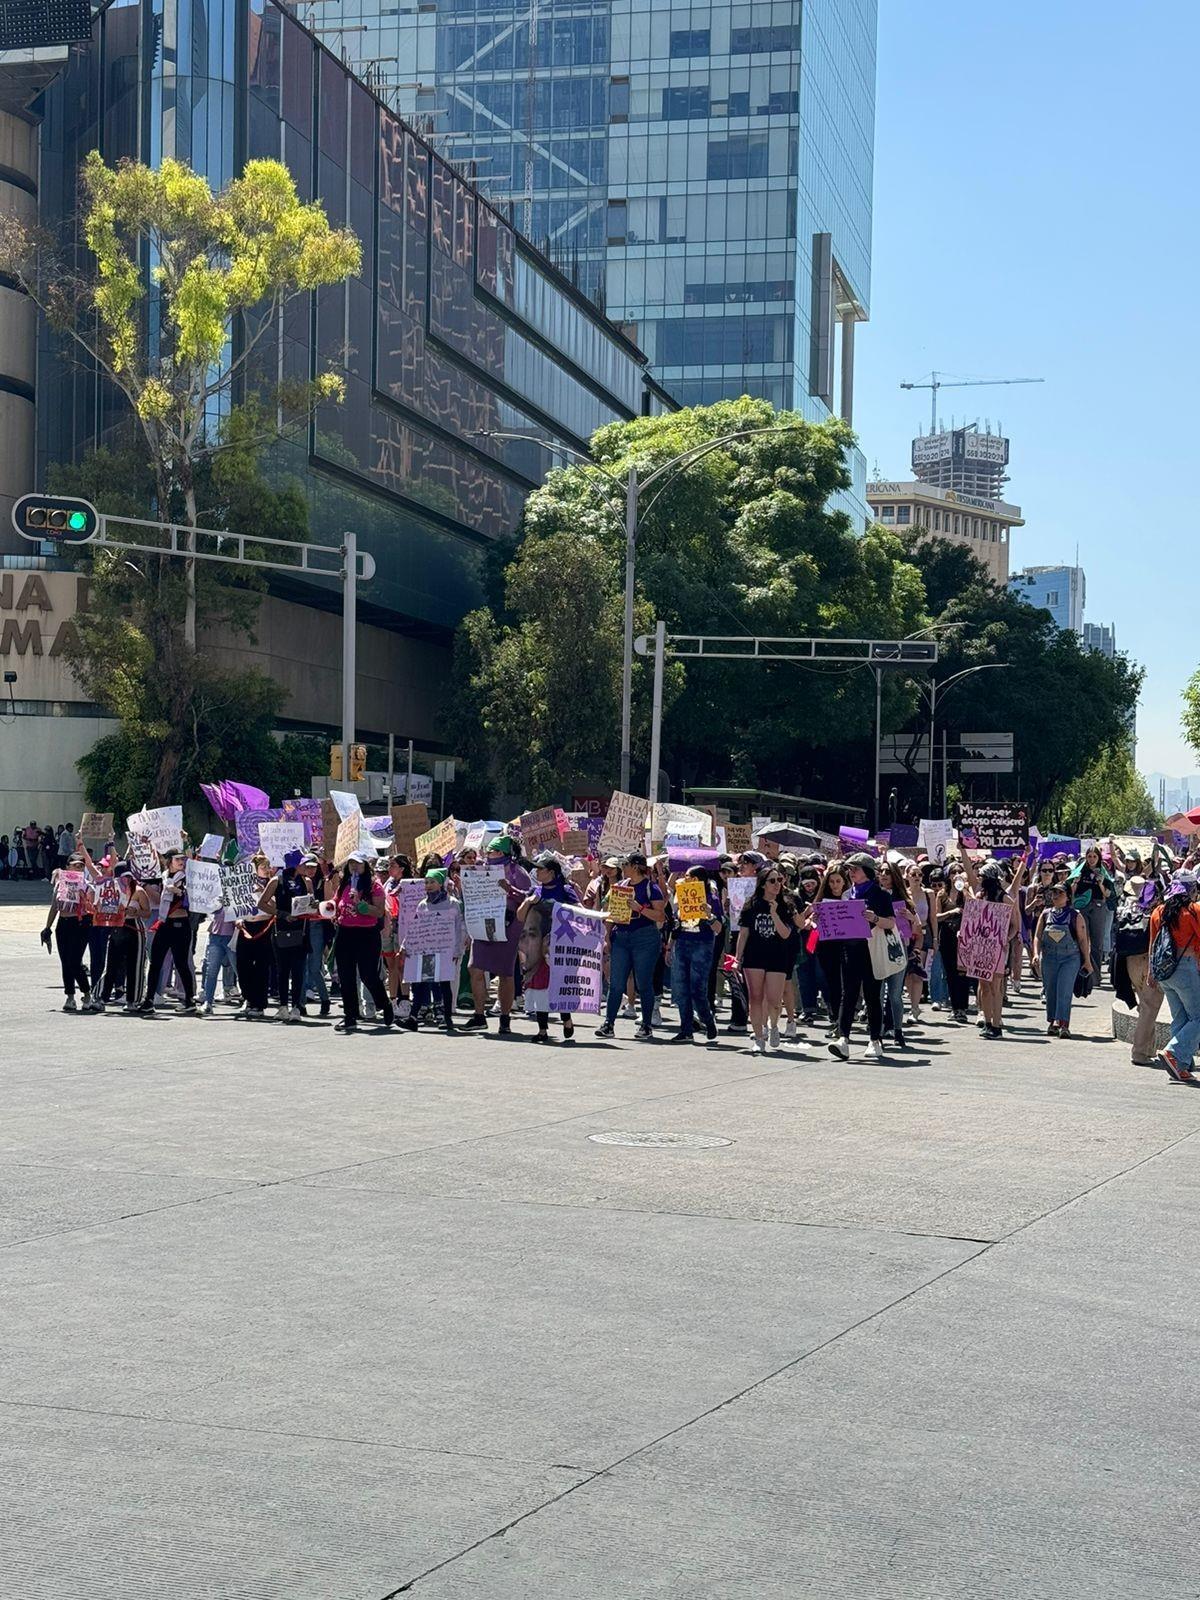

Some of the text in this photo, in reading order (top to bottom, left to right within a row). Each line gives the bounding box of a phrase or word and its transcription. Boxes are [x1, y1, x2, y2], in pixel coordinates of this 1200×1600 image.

[612, 793, 649, 815] AMIGA
[959, 803, 1011, 818] Mi primer
[961, 817, 990, 826] acoso
[1000, 829, 1014, 837] un
[979, 836, 1026, 848] POLICIA
[218, 867, 227, 879] EN
[220, 876, 240, 887] AHORA
[683, 888, 698, 898] YO
[683, 905, 705, 913] CREO
[555, 945, 601, 961] MI HERMANO
[554, 957, 601, 972] MI VIOLADOR
[564, 975, 591, 986] QUIERO
[559, 987, 594, 998] JUSTICIA!
